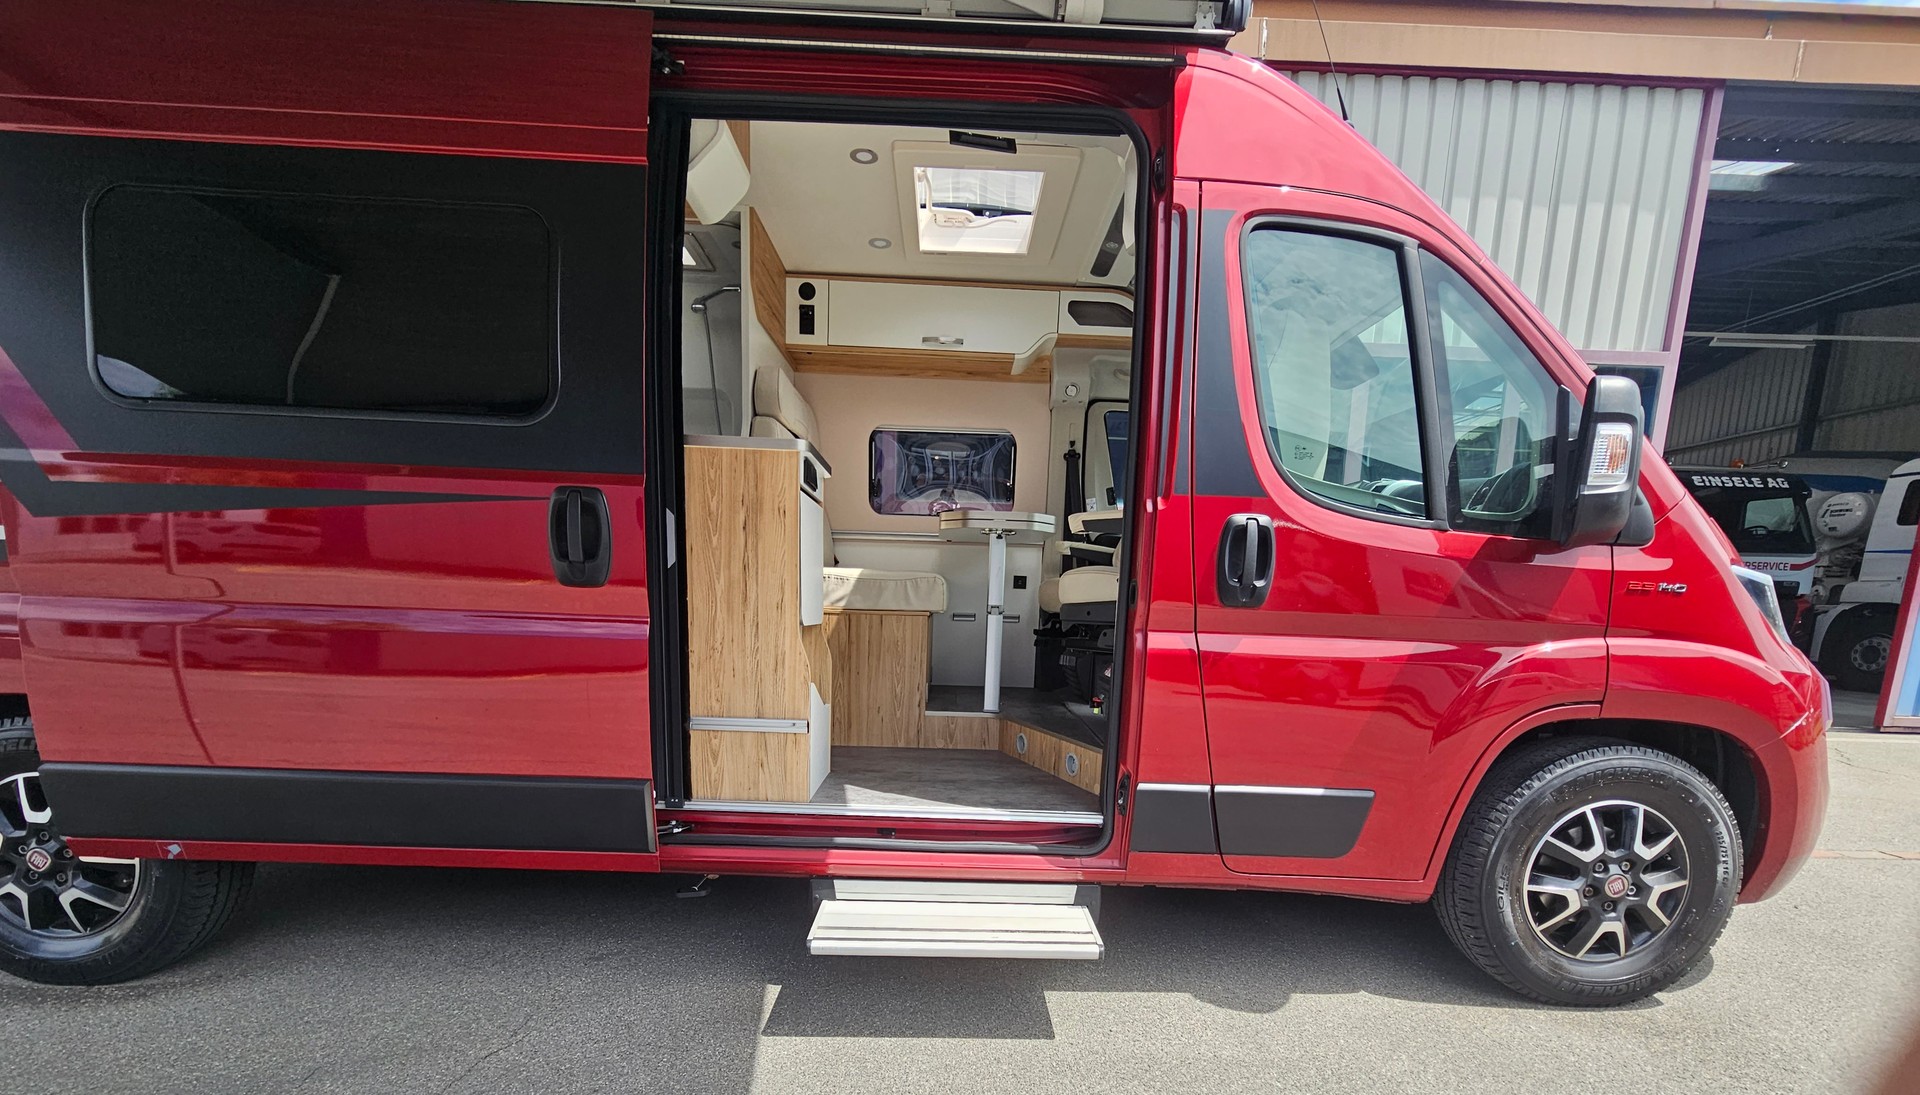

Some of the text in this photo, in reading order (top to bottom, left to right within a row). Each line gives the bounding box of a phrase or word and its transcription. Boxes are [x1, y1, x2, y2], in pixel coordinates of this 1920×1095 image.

[1691, 475, 1790, 489] EINSELE AG
[1743, 561, 1790, 571] RSERVICE
[1657, 581, 1688, 593] 140
[30, 852, 48, 868] FIAT
[1608, 879, 1624, 894] FIAT
